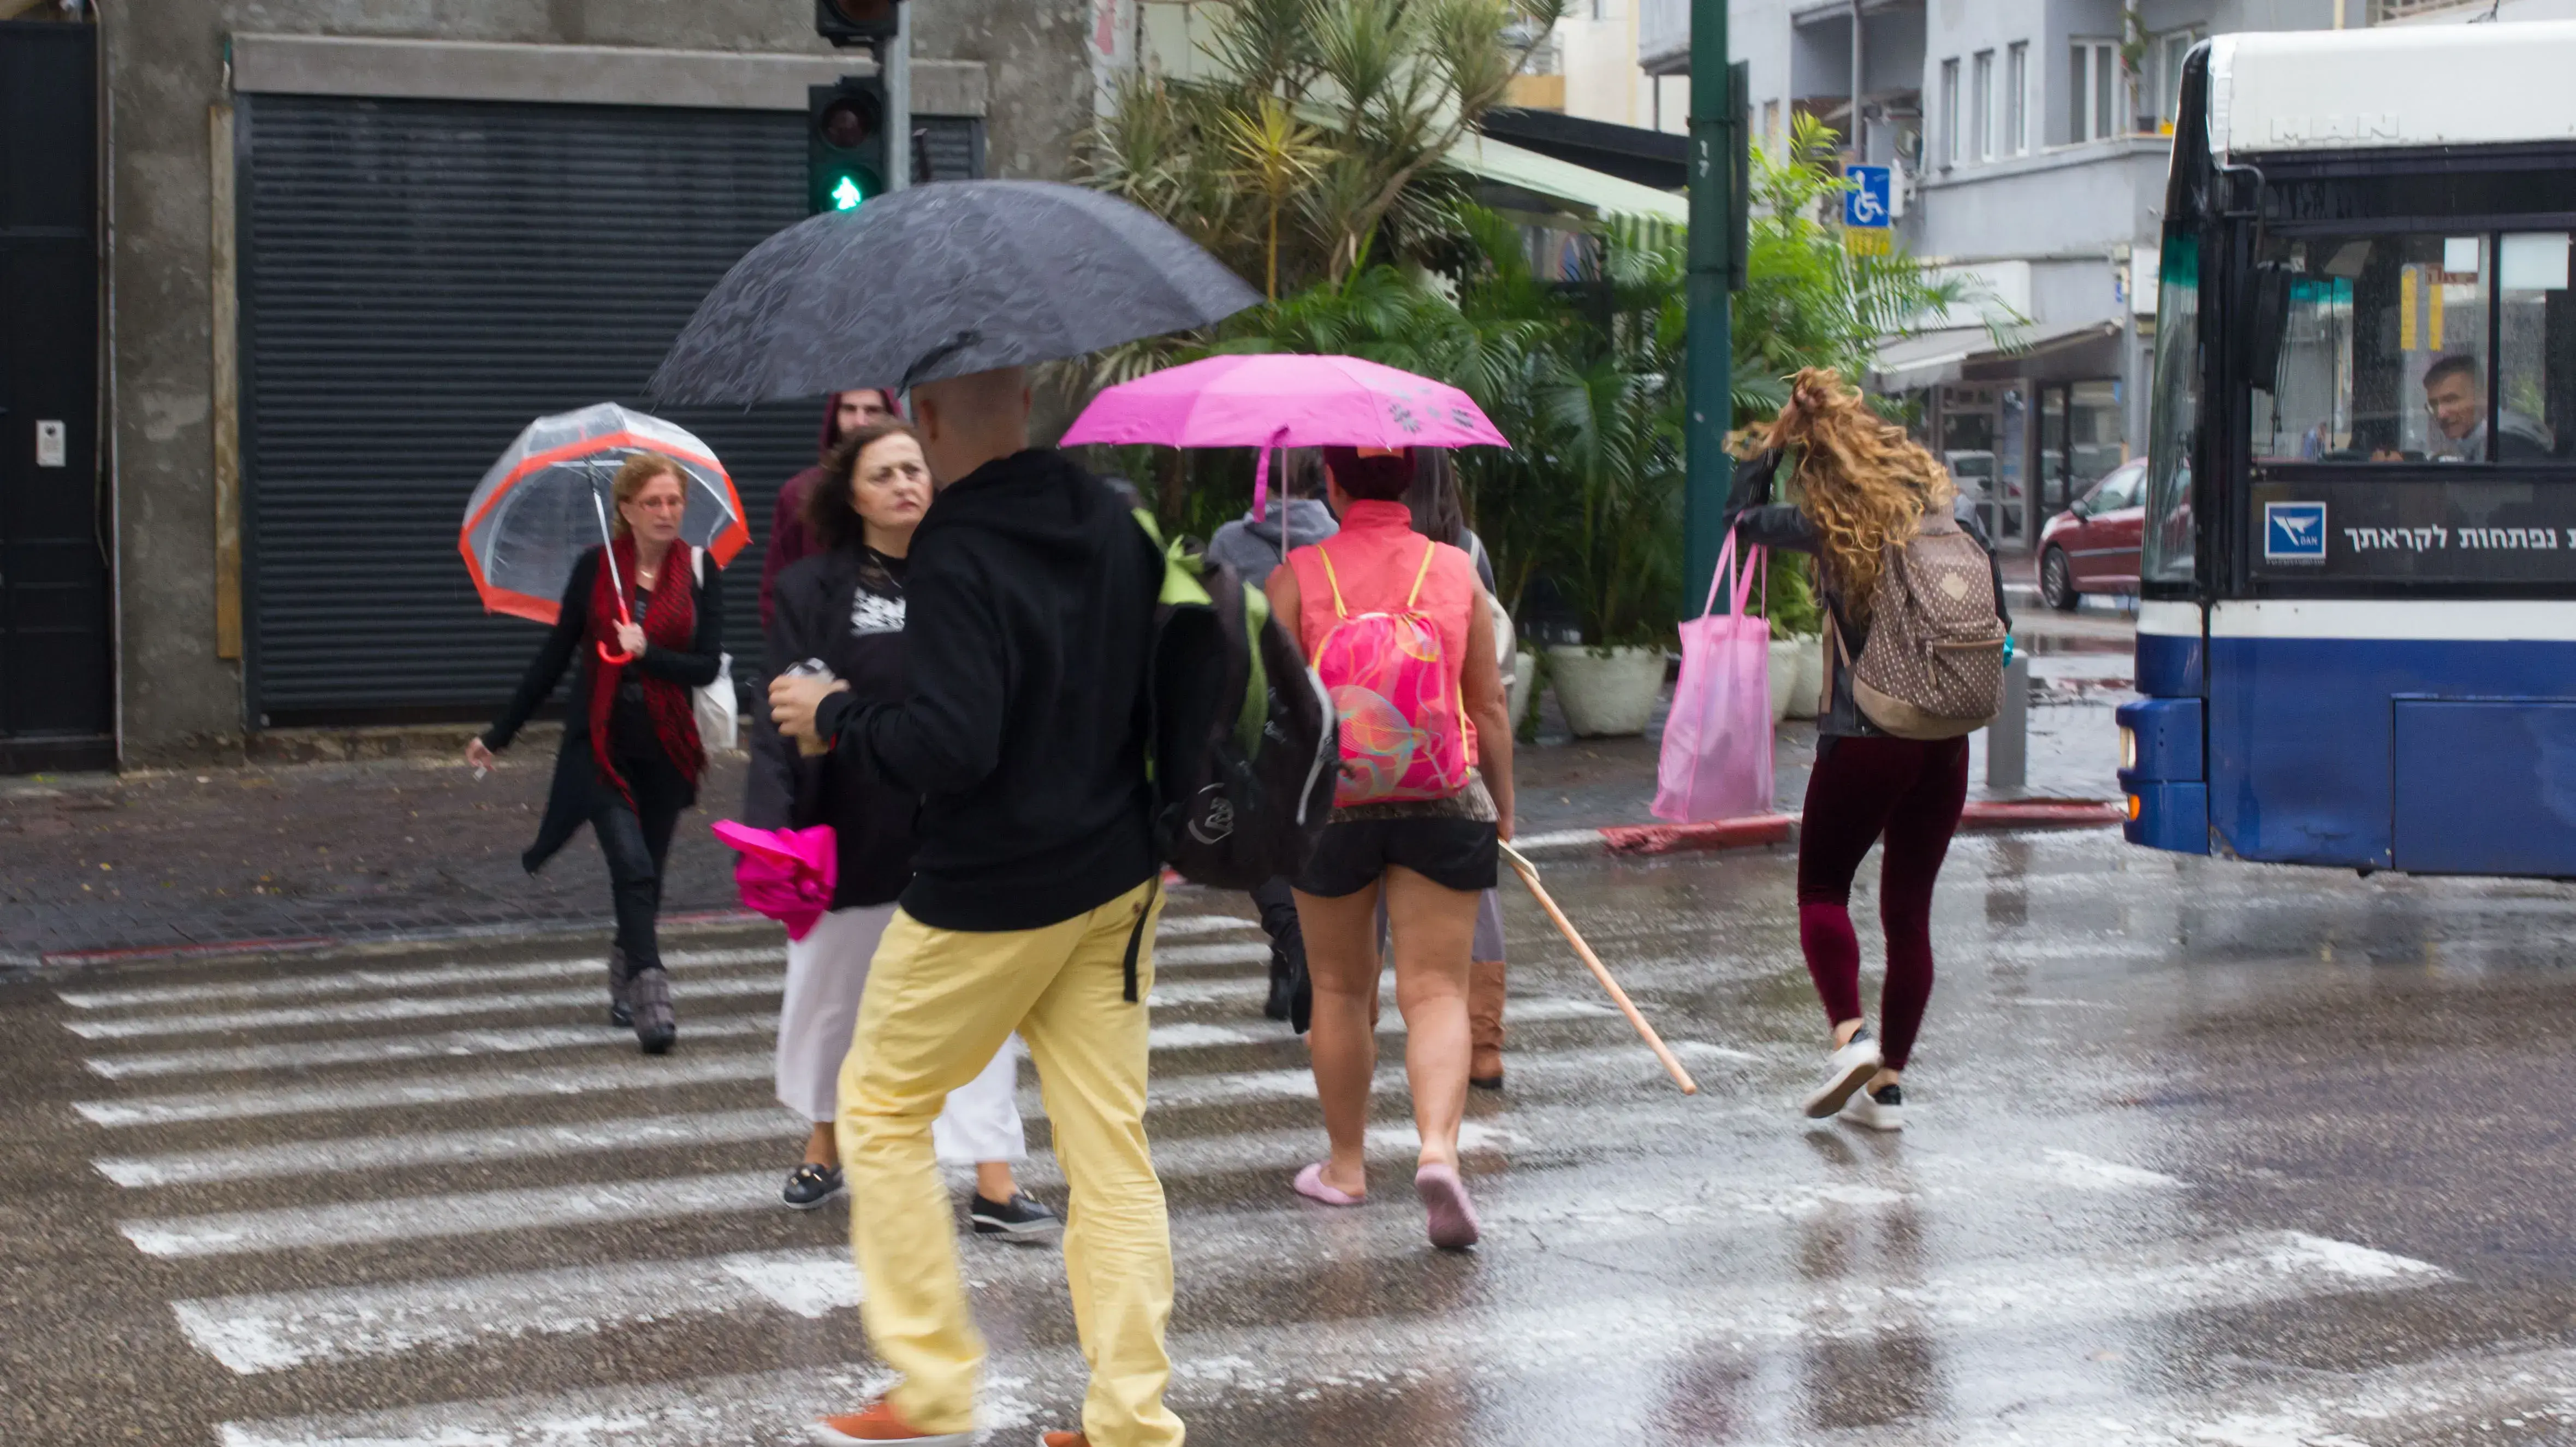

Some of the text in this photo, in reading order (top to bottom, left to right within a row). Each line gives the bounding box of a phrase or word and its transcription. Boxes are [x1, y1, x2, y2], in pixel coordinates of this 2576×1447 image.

[2270, 112, 2400, 142] MAN
[2300, 535, 2318, 546] DAN
[2344, 523, 2447, 553] לקראתך
[2458, 527, 2559, 549] נפתחות
